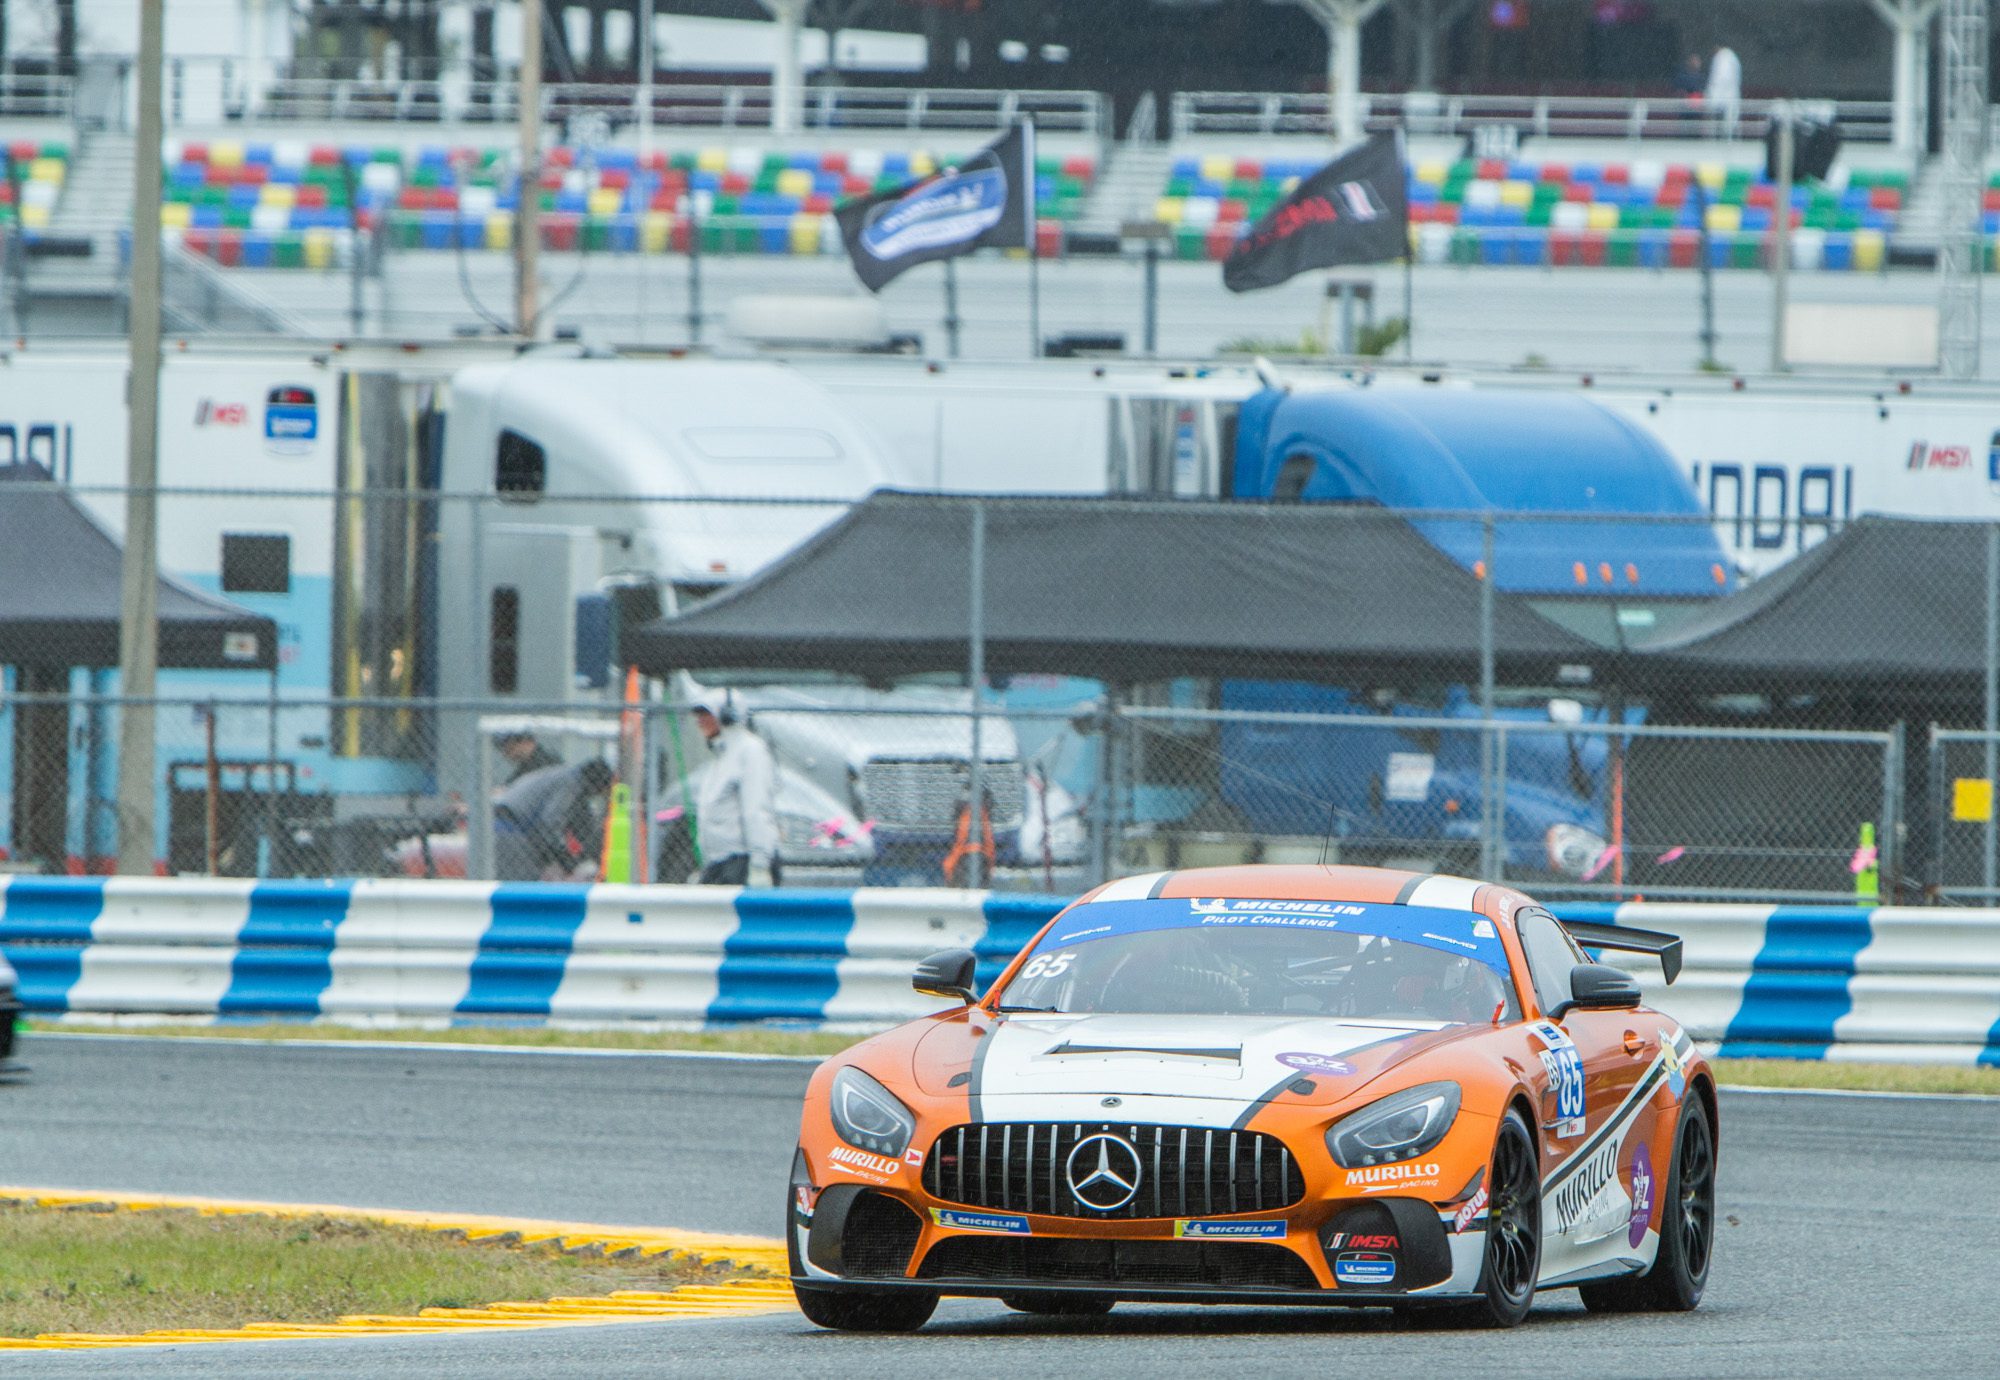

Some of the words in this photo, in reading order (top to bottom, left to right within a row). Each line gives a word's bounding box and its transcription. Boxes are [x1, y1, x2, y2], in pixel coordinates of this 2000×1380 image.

[1232, 900, 1367, 916] MICHELIN
[1201, 914, 1249, 924] PILOT
[1250, 914, 1339, 928] CHALLENGE
[1022, 954, 1077, 979] 65
[1559, 1050, 1583, 1116] 65
[827, 1146, 900, 1174] MURILLO
[1345, 1163, 1441, 1185] MURILLO
[1398, 1179, 1439, 1190] RACING
[1556, 1138, 1618, 1236] MURILLO
[1455, 1187, 1488, 1232] MOTUL
[957, 1217, 1020, 1229] MICHELIN
[1206, 1225, 1278, 1233] MICHELIN
[1347, 1234, 1400, 1248] IMSA
